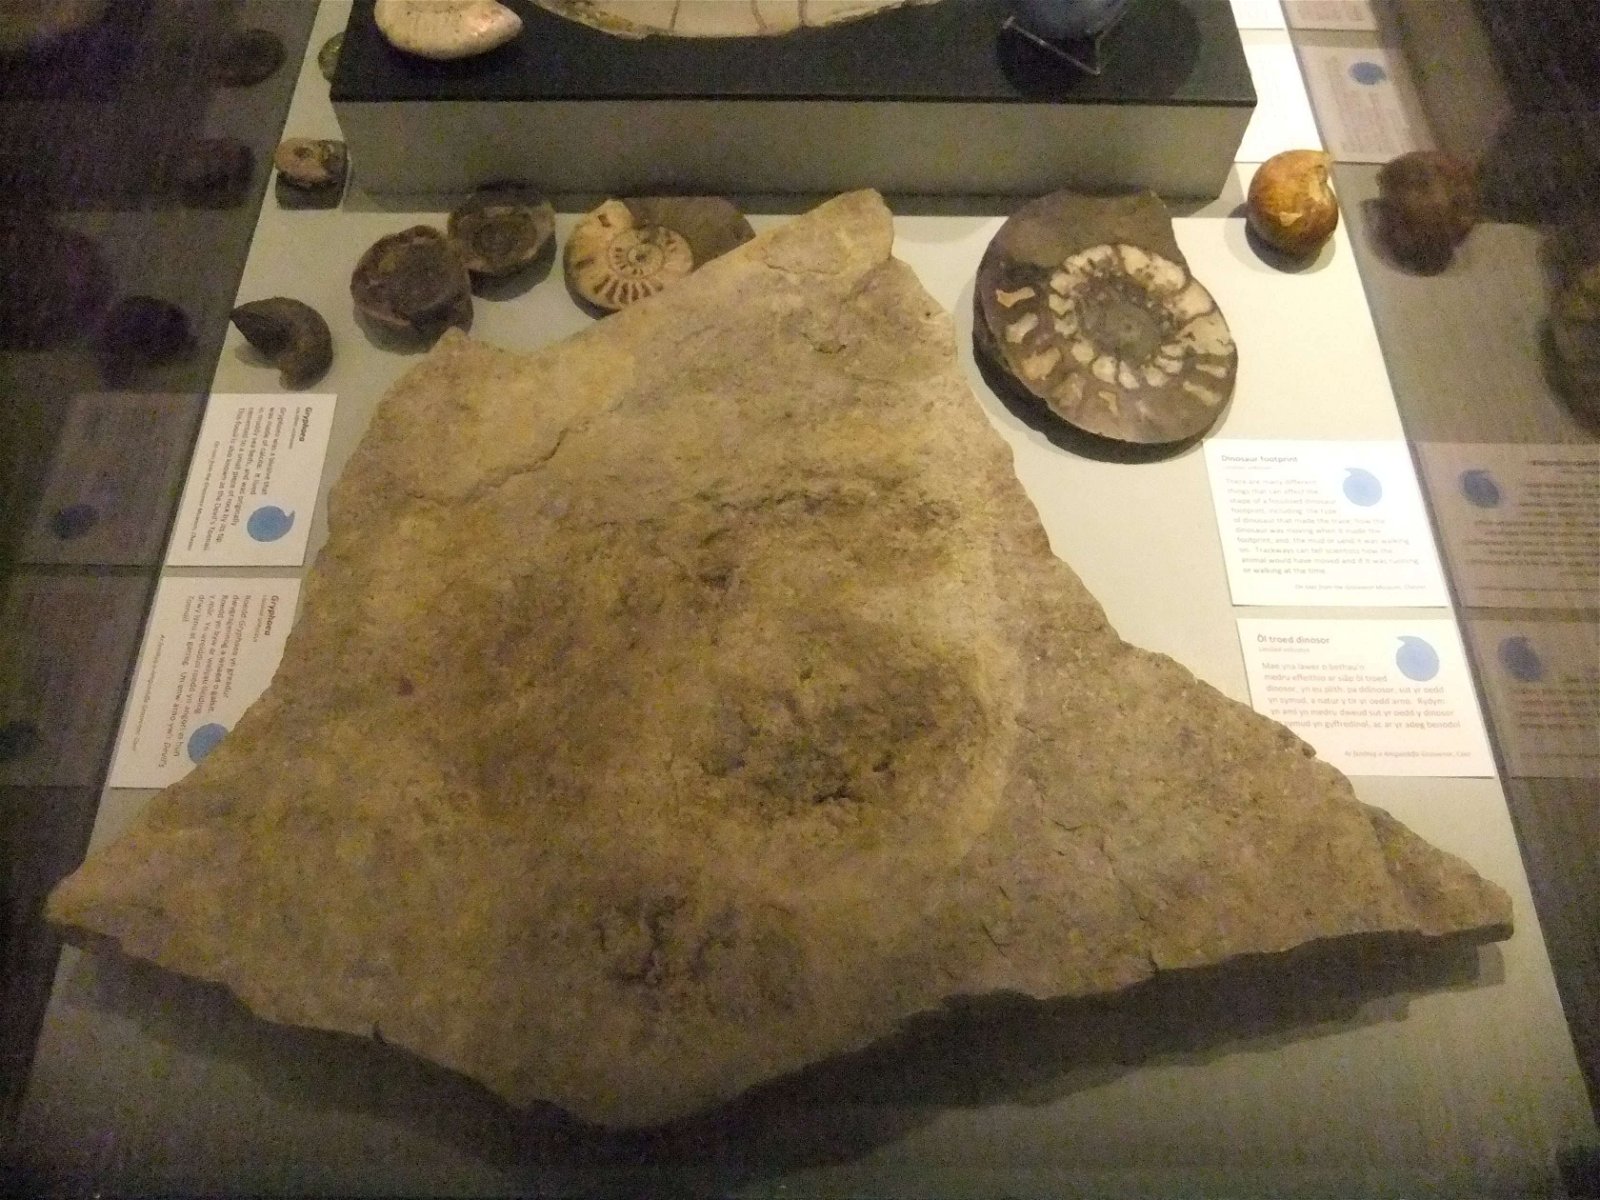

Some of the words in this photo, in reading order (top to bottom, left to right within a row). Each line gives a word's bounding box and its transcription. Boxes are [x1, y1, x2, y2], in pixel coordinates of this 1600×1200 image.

[1260, 455, 1298, 463] footprint
[264, 595, 280, 636] Gryphaea
[1268, 635, 1294, 643] troed
[1295, 636, 1330, 644] dinosor
